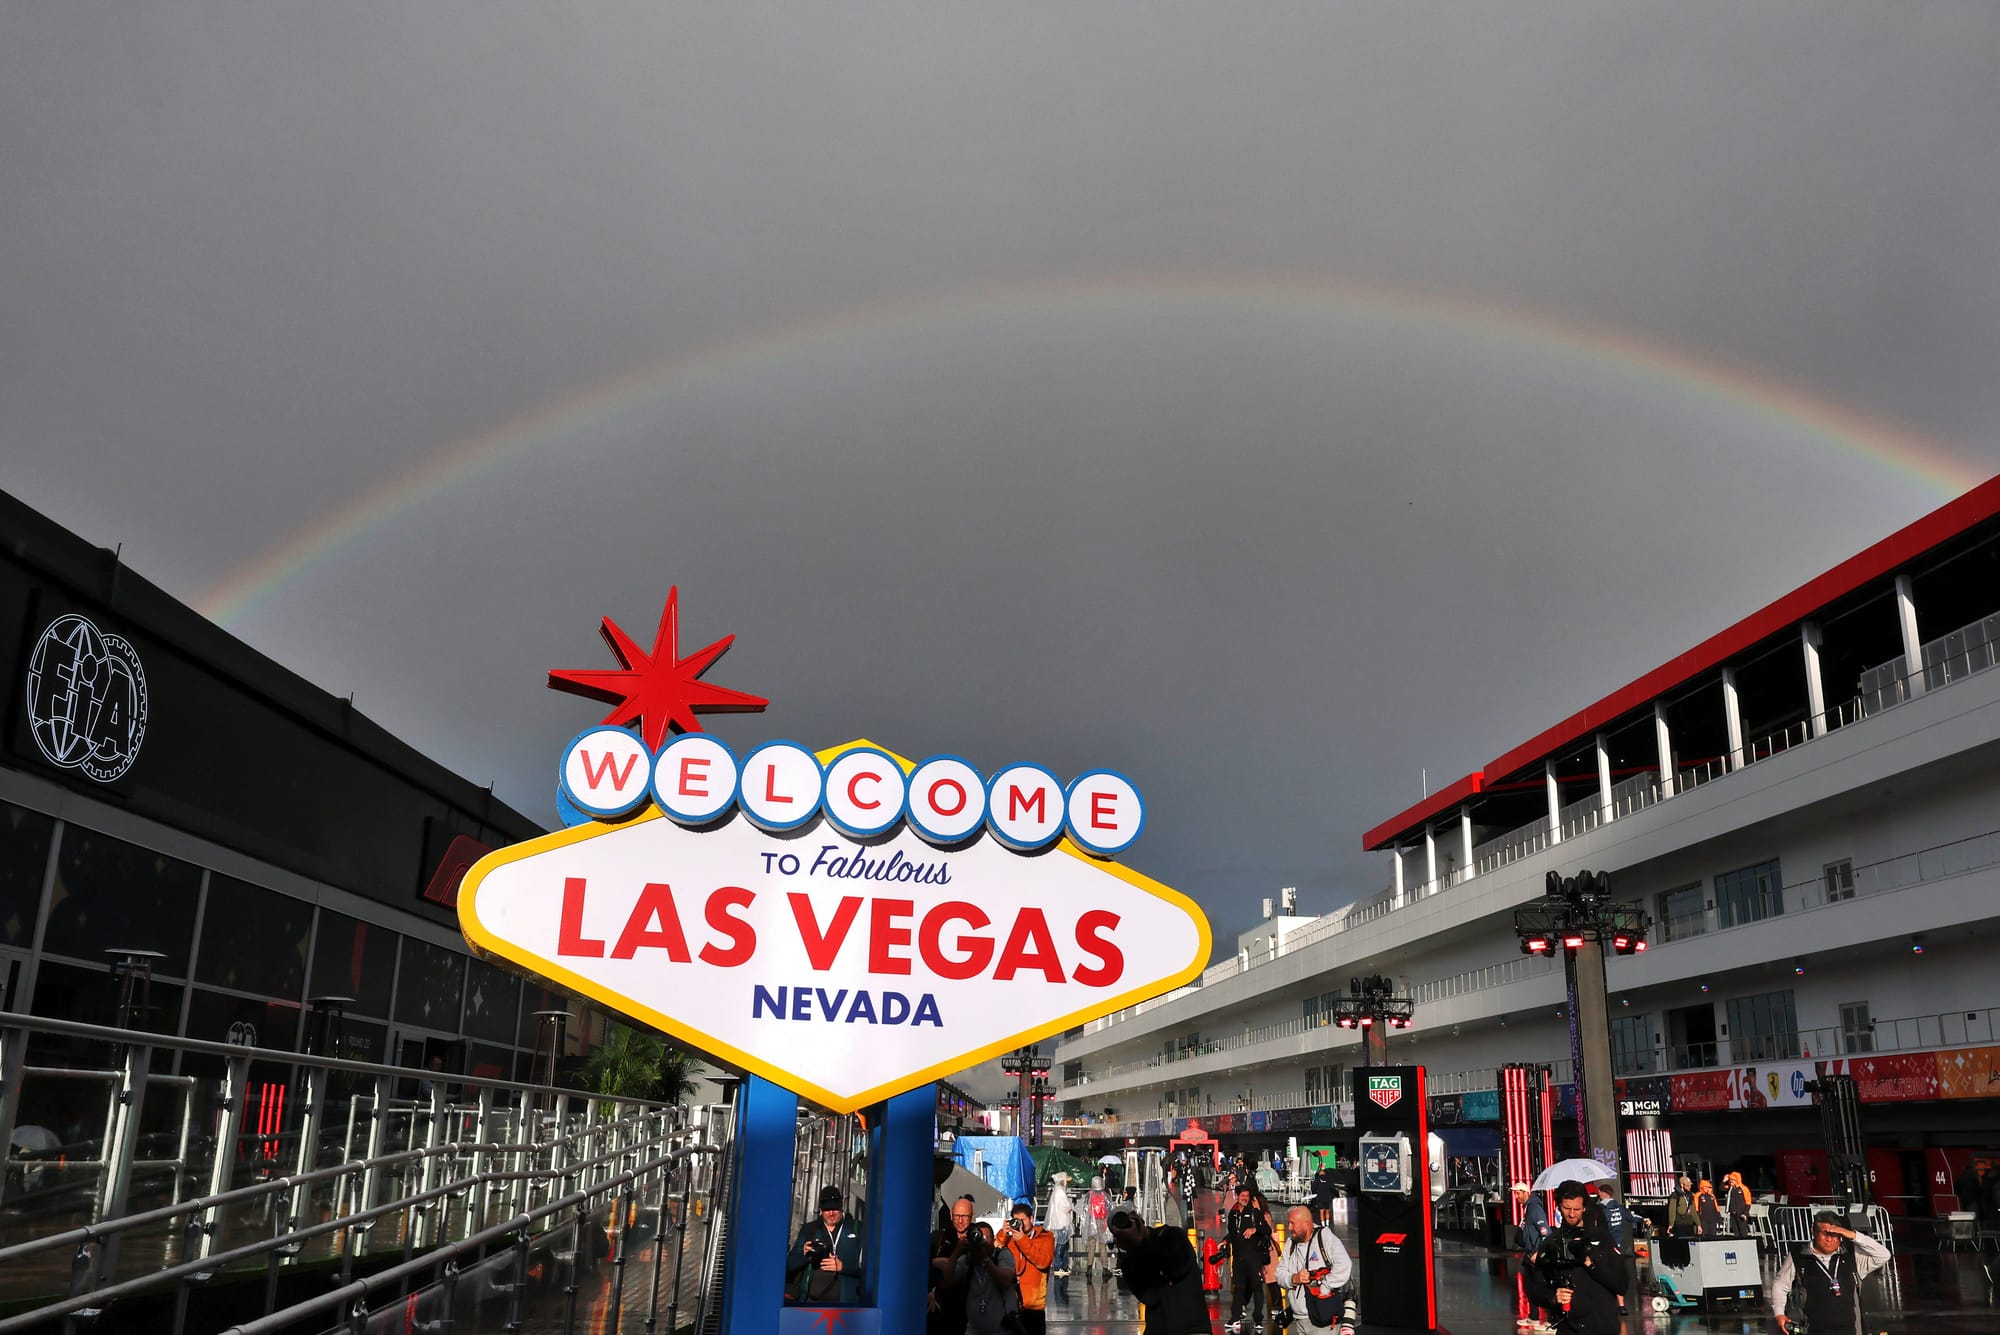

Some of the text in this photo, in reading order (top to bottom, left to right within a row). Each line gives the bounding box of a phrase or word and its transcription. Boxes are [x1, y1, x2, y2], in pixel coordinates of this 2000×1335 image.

[580, 749, 1118, 830] WELCOME
[761, 845, 952, 885] TO Fabulous
[557, 877, 1125, 988] LAS VEGAS
[752, 984, 944, 1027] NEVADA
[1371, 1078, 1399, 1089] TAG
[1371, 1090, 1400, 1105] HEUER
[1727, 1069, 1751, 1109] 16
[1792, 1071, 1805, 1099] hp
[1635, 1101, 1660, 1110] MGM
[1935, 1171, 1946, 1185] 44
